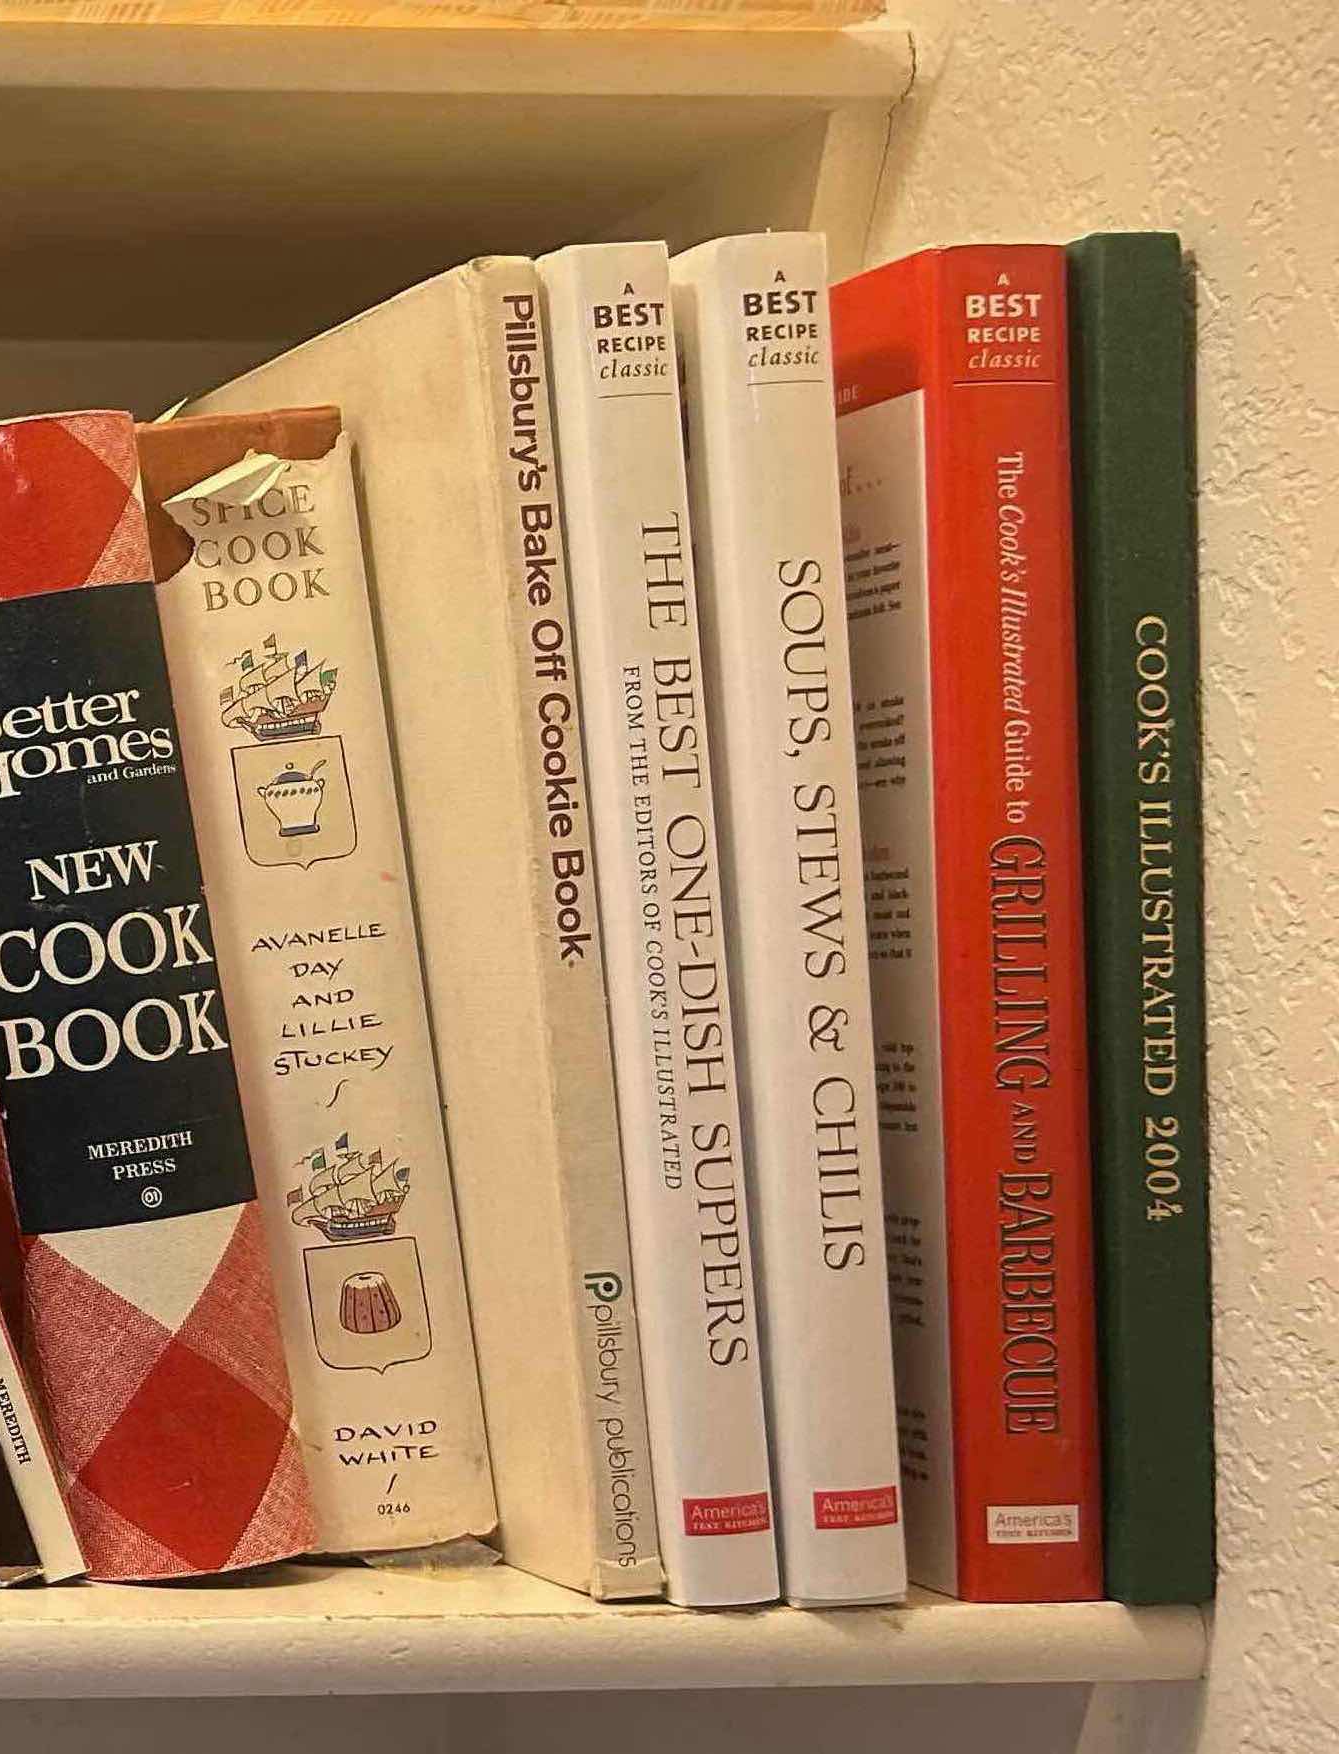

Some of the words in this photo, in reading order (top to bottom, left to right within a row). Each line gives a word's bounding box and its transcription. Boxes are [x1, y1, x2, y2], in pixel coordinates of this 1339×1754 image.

[622, 282, 634, 296] A
[774, 270, 786, 282] A
[997, 273, 1010, 286] A
[593, 303, 665, 329] BEST
[743, 290, 818, 316] BEST
[966, 294, 1042, 319] BEST
[597, 336, 666, 354] RECIPE
[746, 324, 818, 342] RECIPE
[968, 327, 1041, 343] RECIPE
[600, 359, 668, 379] classic
[748, 348, 819, 368] classic
[968, 350, 1041, 369] classic
[502, 293, 548, 492] Pillsbury's
[997, 451, 1024, 499] The
[194, 526, 324, 569] COOK
[520, 503, 557, 608] Bake
[998, 504, 1028, 582] Cook's
[202, 568, 330, 612] BOOK
[641, 510, 688, 629] THE
[531, 619, 567, 683] Off
[778, 558, 832, 757] SOUPS,
[1000, 587, 1031, 716] Illustrated
[622, 664, 644, 729] FROM
[1135, 614, 1172, 785] COOK'S
[652, 657, 702, 788] BEST
[86, 769, 120, 786] and
[538, 692, 578, 839] Cookie
[628, 738, 650, 786] THE
[1004, 719, 1032, 794] Guide
[1005, 799, 1033, 824] to
[634, 793, 659, 895] EDITORS
[25, 839, 159, 901] NEW
[793, 784, 846, 978] STEWS
[250, 922, 387, 952] AVANELLE
[642, 902, 661, 933] OF
[289, 958, 344, 979] DAY
[666, 814, 727, 1097] ONE-DISH
[989, 835, 1051, 1092] GRILLING
[1138, 800, 1177, 1097] ILLUSTRATED
[292, 988, 354, 1009] AND
[643, 940, 669, 1021] COOK'S
[281, 1012, 384, 1039] LILLIE
[808, 1005, 849, 1052] &
[274, 1045, 394, 1077] STUCKEY
[652, 1029, 683, 1191] ILLUSTRATED
[1009, 1098, 1039, 1163] AND
[87, 1130, 194, 1160] MEREDITH
[1145, 1115, 1182, 1222] 2004
[112, 1158, 177, 1181] PRESS
[813, 1076, 865, 1270] CHILIS
[691, 1122, 748, 1367] SUPPERS
[997, 1169, 1059, 1436] BARBECUE
[587, 1304, 624, 1405] pillsbury
[333, 1420, 438, 1442] DAVID
[338, 1444, 440, 1467] WHITE
[377, 1503, 411, 1516] 0246
[598, 1417, 638, 1568] publications
